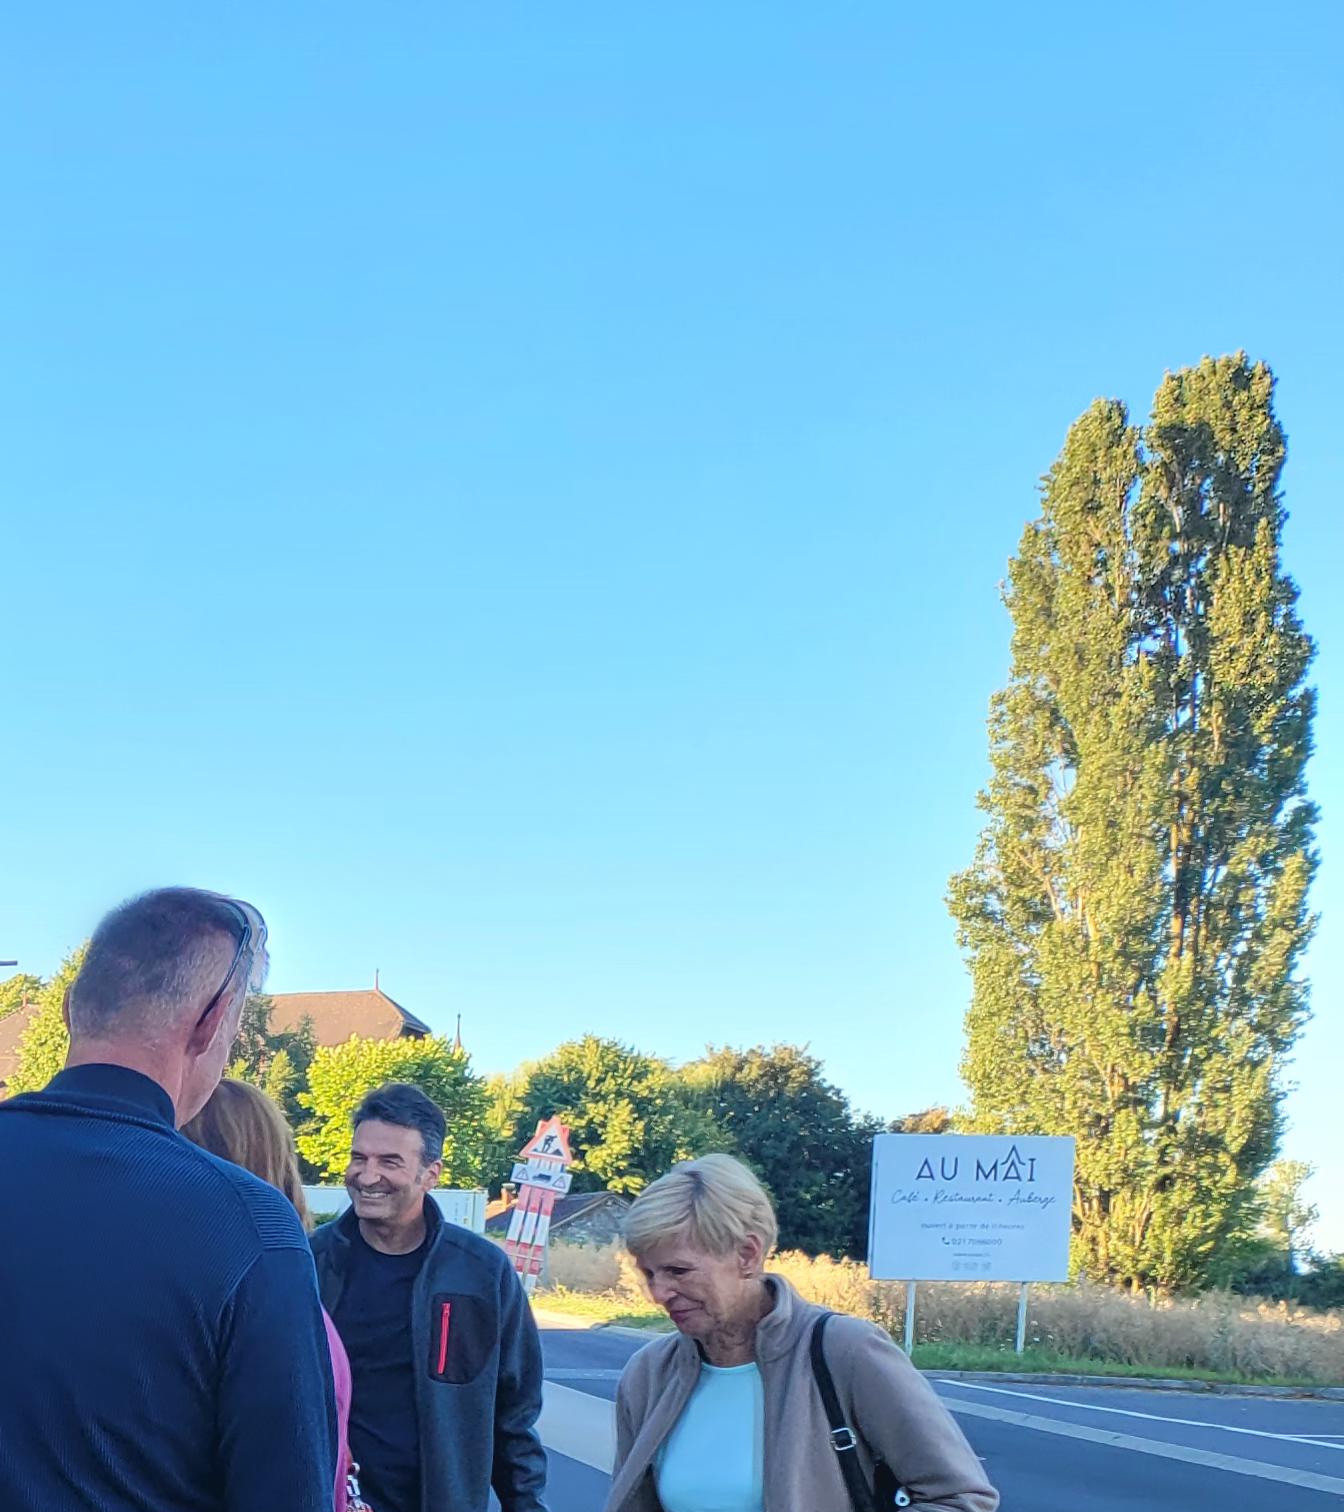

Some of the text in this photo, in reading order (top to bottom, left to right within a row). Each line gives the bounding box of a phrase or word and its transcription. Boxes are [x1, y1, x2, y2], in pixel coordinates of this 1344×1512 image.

[915, 1144, 1037, 1183] AU MÂI
[890, 1187, 1057, 1210] Café Restaurant Auberge
